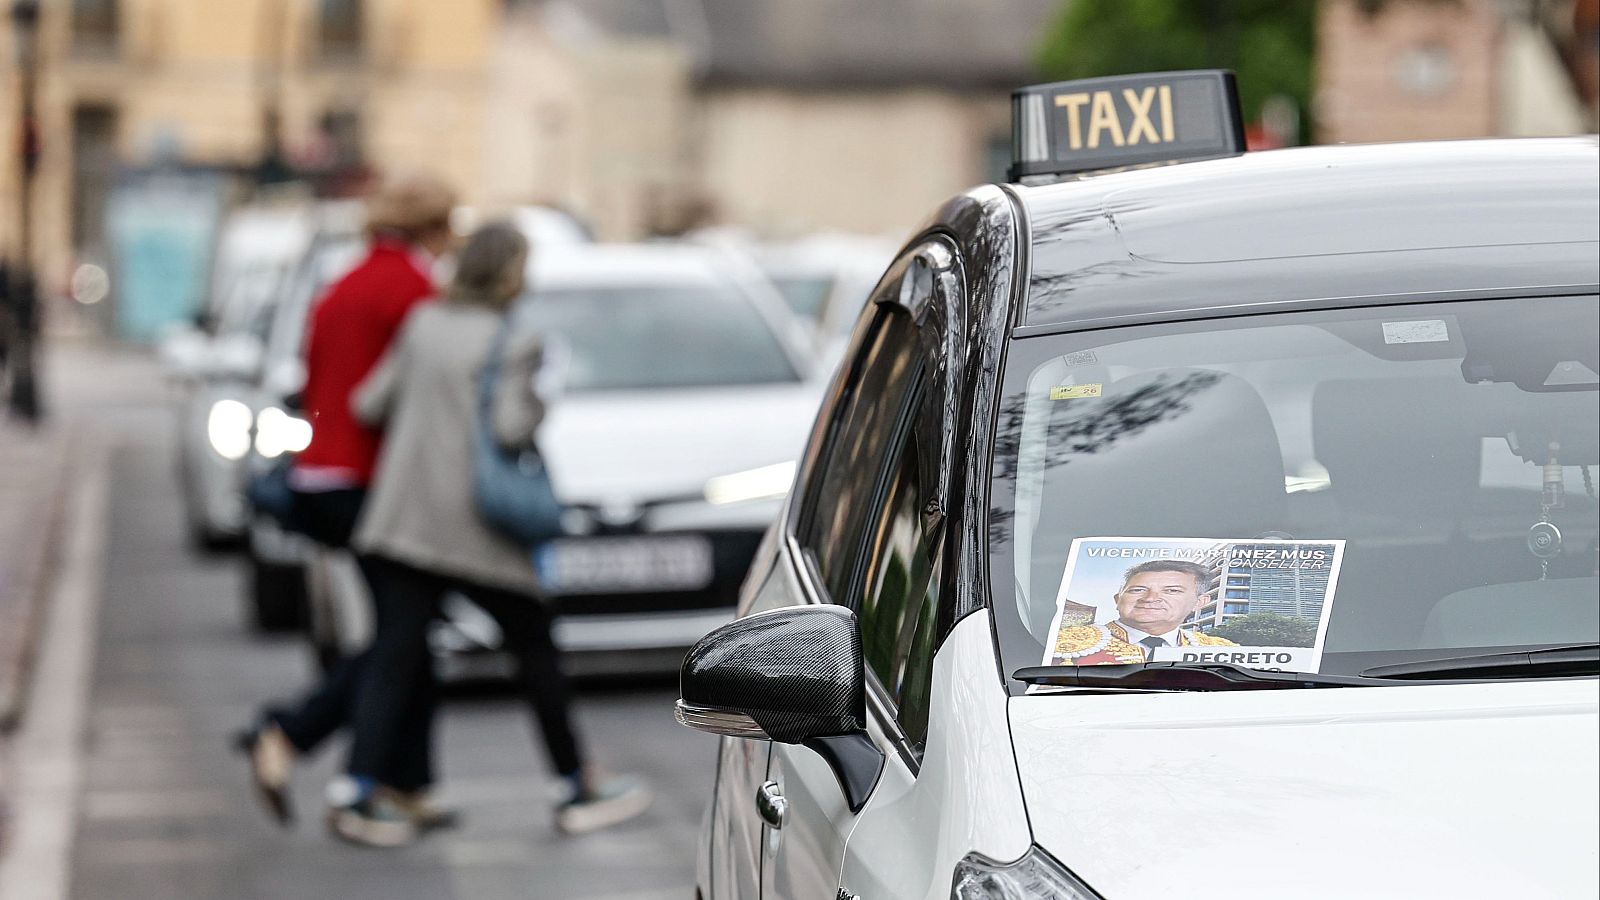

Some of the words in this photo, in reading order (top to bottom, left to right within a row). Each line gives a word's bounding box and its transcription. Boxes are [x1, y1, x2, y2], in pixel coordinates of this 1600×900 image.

[1054, 85, 1175, 149] TAXI
[1086, 547, 1169, 559] VICENTE
[1174, 548, 1278, 560] MARTINEZ
[1279, 549, 1326, 560] MUS
[1215, 558, 1325, 570] CONSELLER
[1182, 652, 1293, 664] DECRETO
